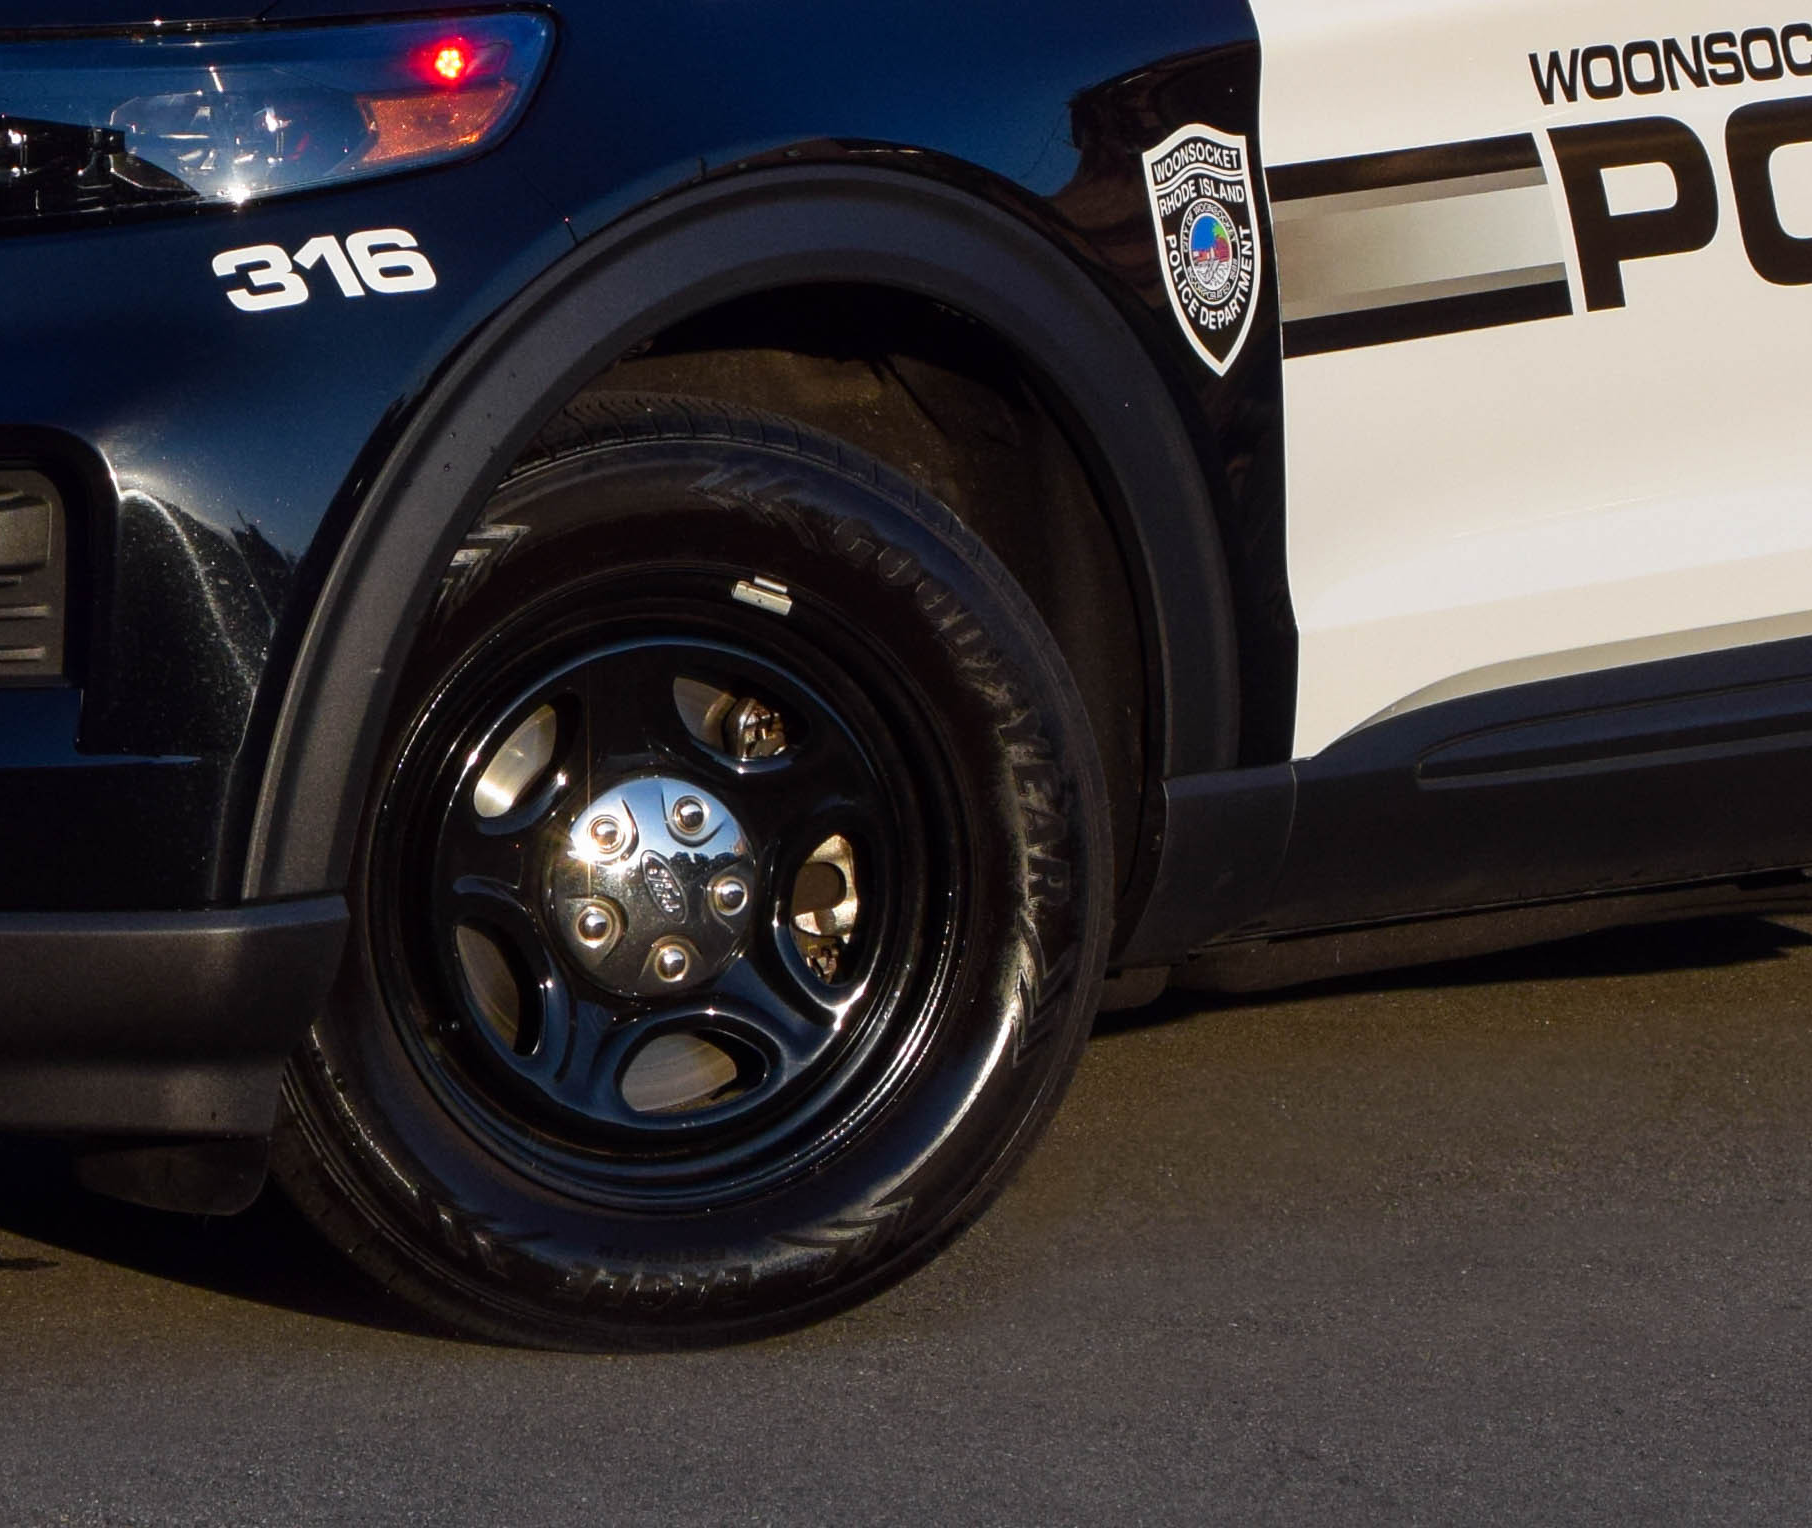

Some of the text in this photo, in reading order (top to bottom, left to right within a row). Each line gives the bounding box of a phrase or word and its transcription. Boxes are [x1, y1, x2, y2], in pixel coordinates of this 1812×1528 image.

[1153, 141, 1238, 183] WOONSOCKET
[1158, 176, 1245, 217] RHODE ISLAND
[211, 228, 438, 311] 316
[1164, 224, 1252, 331] POLICE DEPARTMENT
